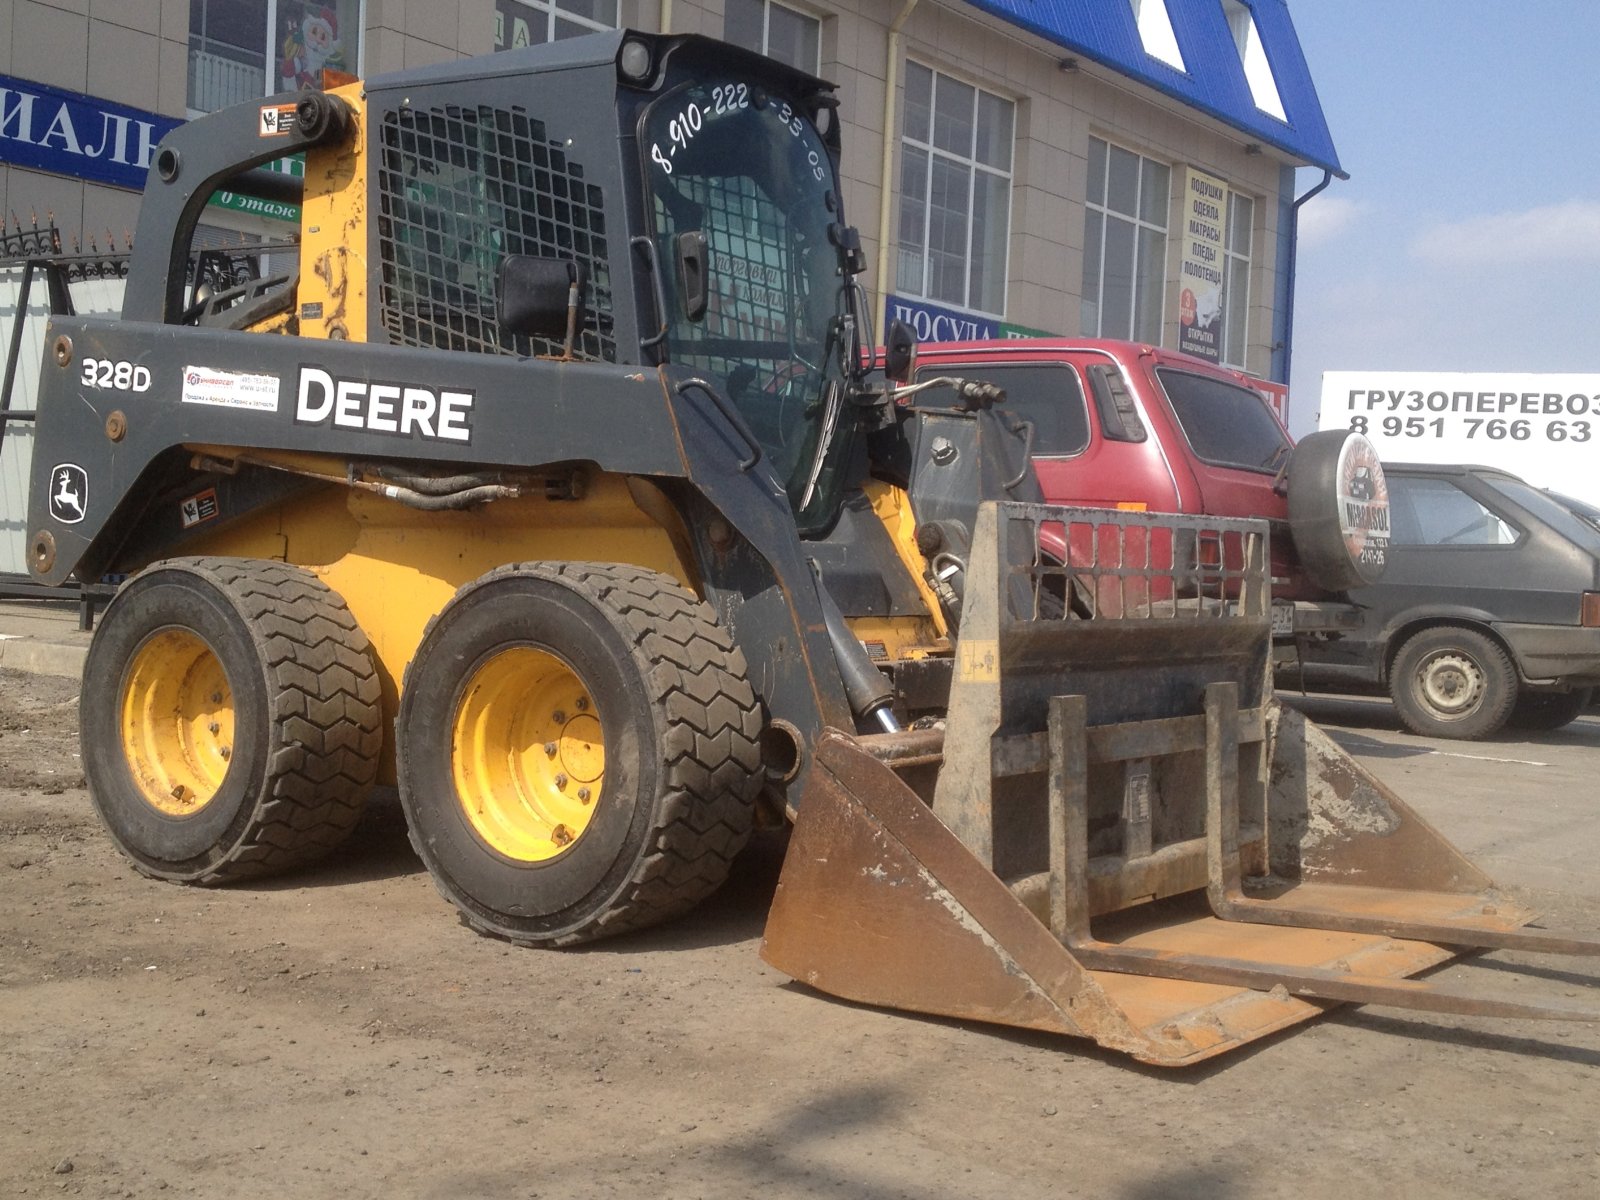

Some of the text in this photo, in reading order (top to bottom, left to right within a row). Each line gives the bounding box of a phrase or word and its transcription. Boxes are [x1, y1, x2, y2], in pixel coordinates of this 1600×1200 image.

[1191, 177, 1223, 201] ПОДУШКИ
[1193, 199, 1219, 221] ОДЕЯЛА
[1189, 219, 1221, 242] МАТРАСЫ
[1192, 242, 1216, 262] ПЛЕДЫ
[1184, 261, 1222, 285] ПОЛОТЕНЦА
[81, 359, 151, 392] 328D
[296, 367, 472, 441] DEERE
[1350, 415, 1592, 443] 8 951 766 63
